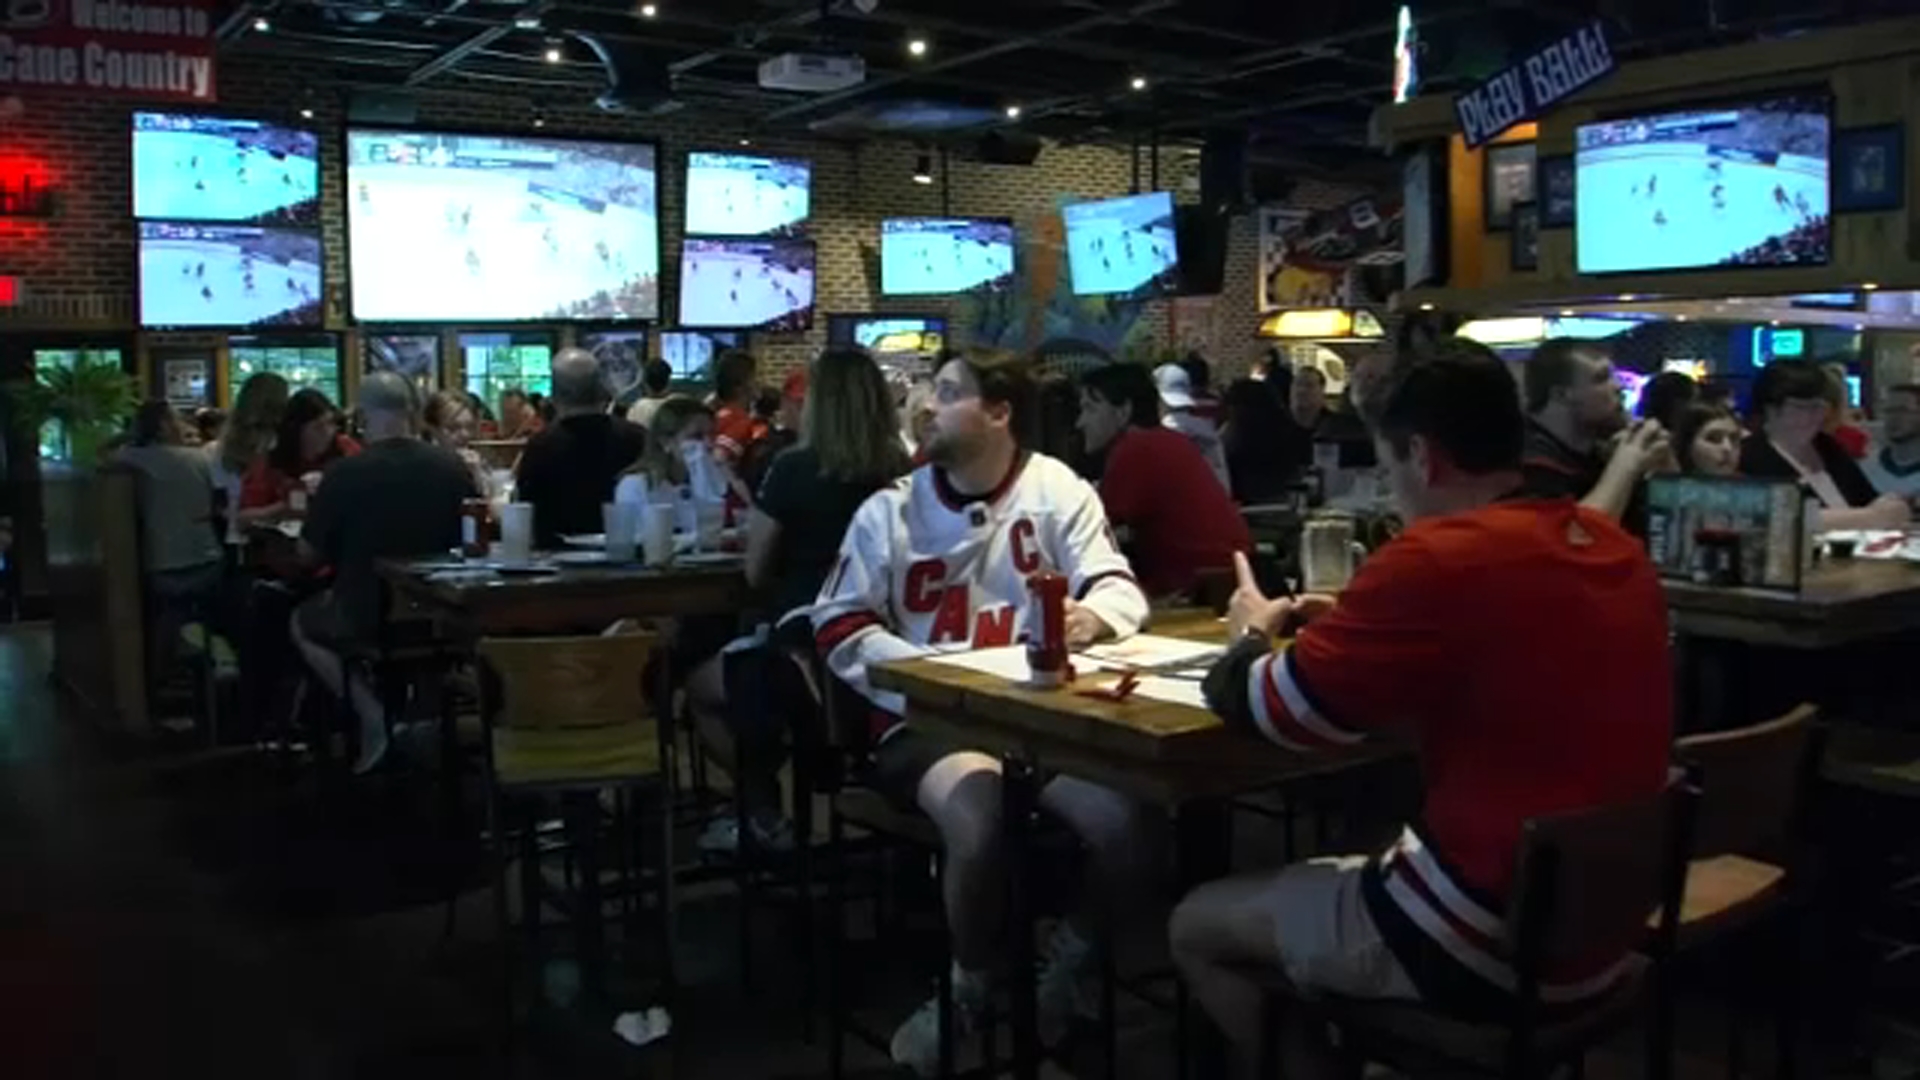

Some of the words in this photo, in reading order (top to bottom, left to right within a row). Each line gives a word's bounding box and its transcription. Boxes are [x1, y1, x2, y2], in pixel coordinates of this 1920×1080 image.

[71, 0, 182, 35] Welcome
[184, 7, 209, 37] to
[0, 34, 77, 84] Cane
[83, 40, 211, 97] Country
[1457, 65, 1527, 146] PLAY
[1525, 21, 1612, 104] BALL!
[1010, 519, 1039, 573] C
[905, 560, 1028, 649] CAN
